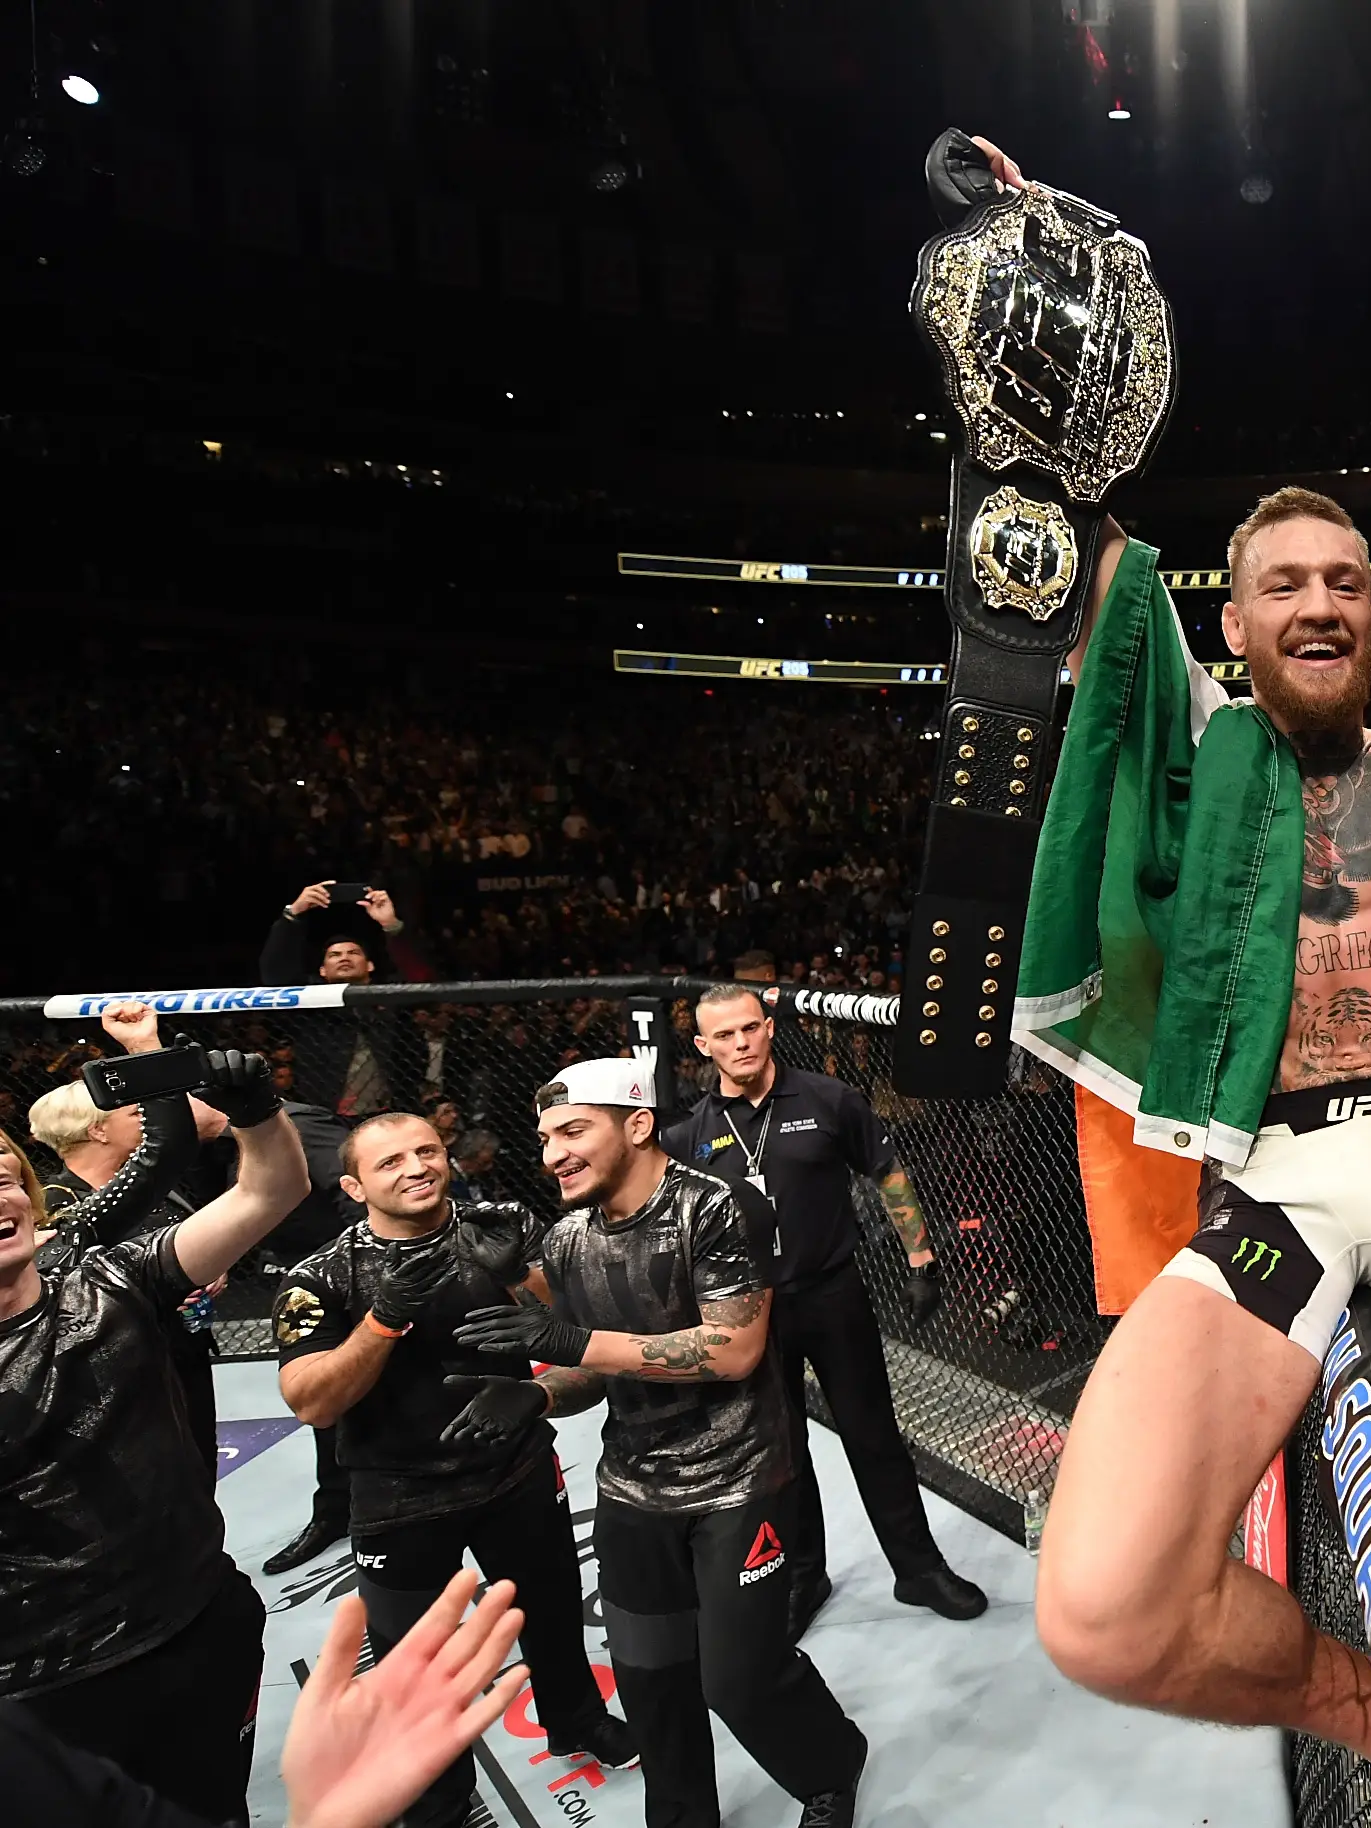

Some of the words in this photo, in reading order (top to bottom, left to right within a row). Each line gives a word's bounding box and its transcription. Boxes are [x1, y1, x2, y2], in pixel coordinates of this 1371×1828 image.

[740, 563, 781, 579] UFC
[740, 659, 781, 676] UFC
[476, 877, 522, 892] BUD
[193, 987, 305, 1011] TIRES
[712, 1133, 735, 1150] MMA
[645, 1229, 681, 1243] Reebo
[356, 1551, 387, 1569] UFC
[740, 1552, 785, 1587] Reebok
